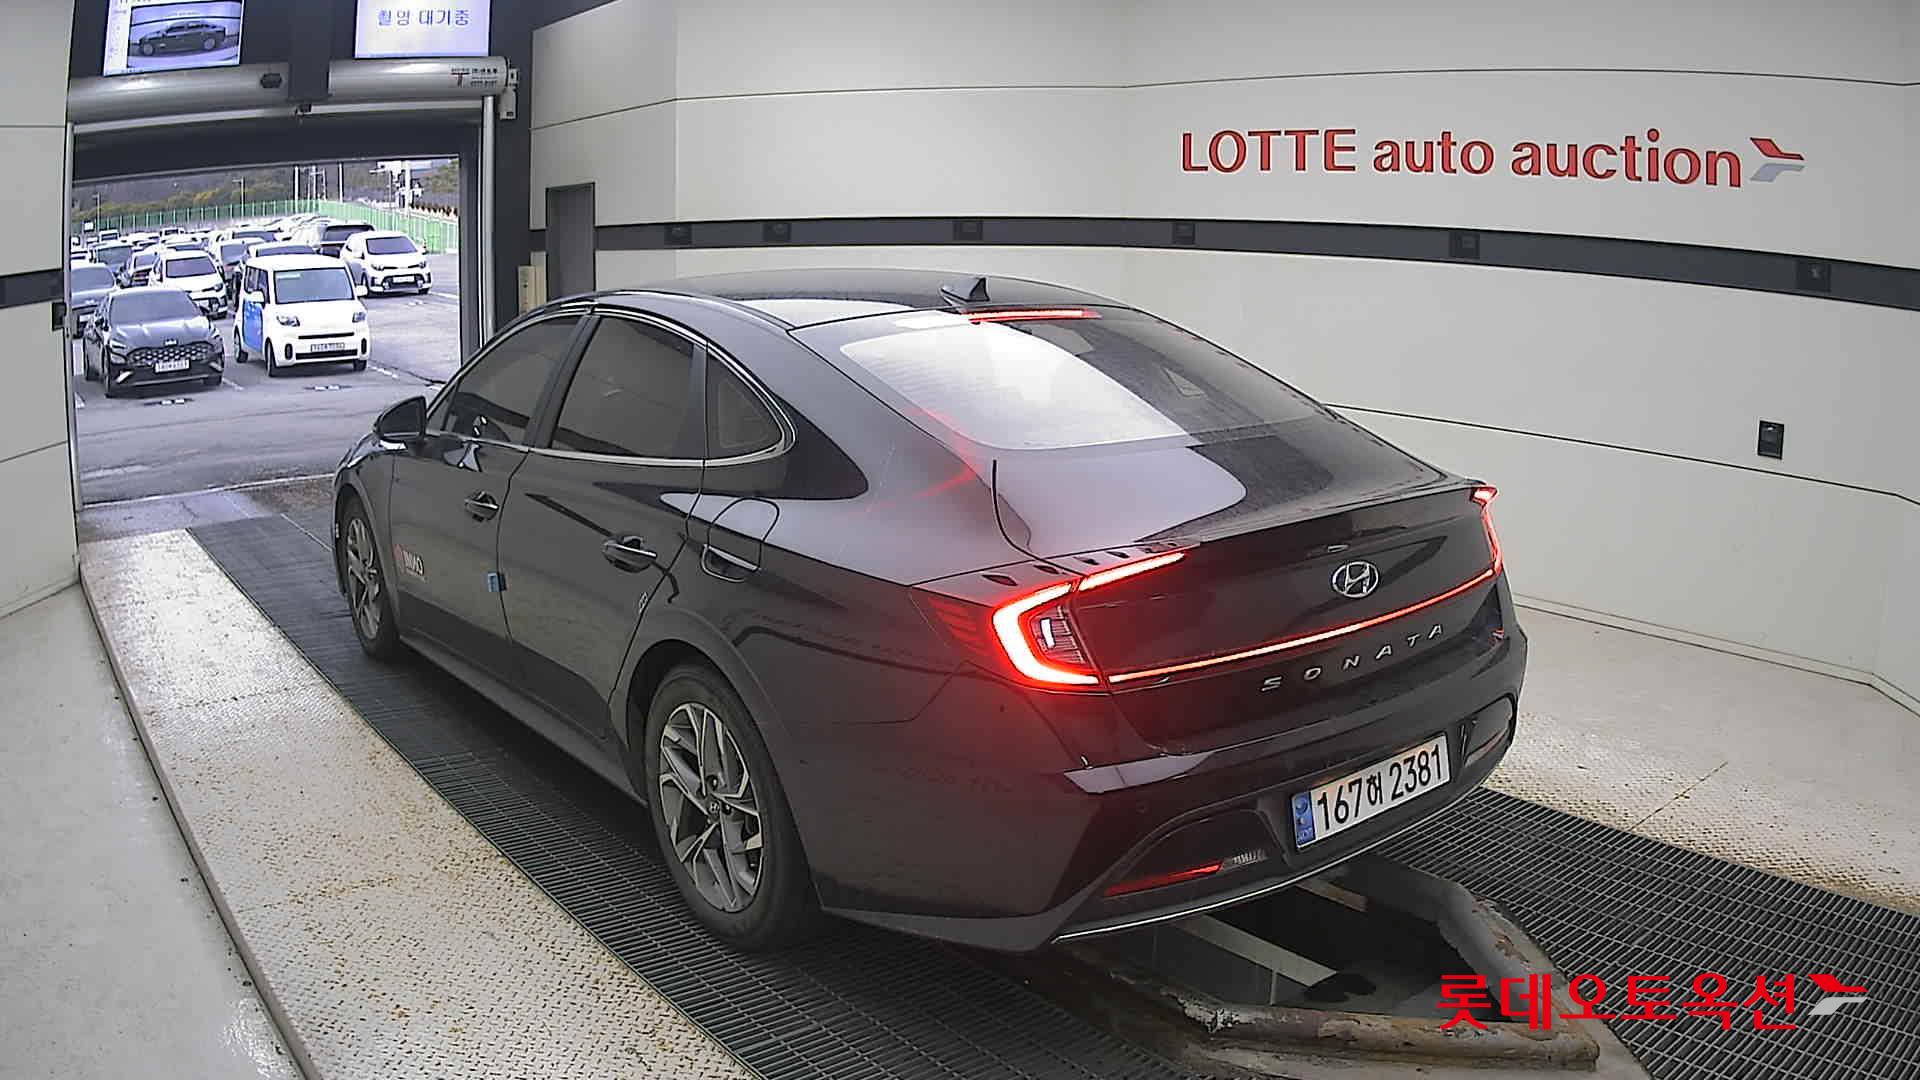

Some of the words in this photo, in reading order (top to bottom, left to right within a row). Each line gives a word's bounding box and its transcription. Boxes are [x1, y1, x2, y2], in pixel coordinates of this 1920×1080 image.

[419, 8, 471, 26] 대기중
[1182, 128, 1356, 173] LOTTE
[1374, 131, 1494, 175] auto
[1512, 128, 1742, 188] auction
[1261, 624, 1444, 692] SONATA
[1317, 772, 1384, 831] 167허
[1389, 744, 1442, 801] 2381
